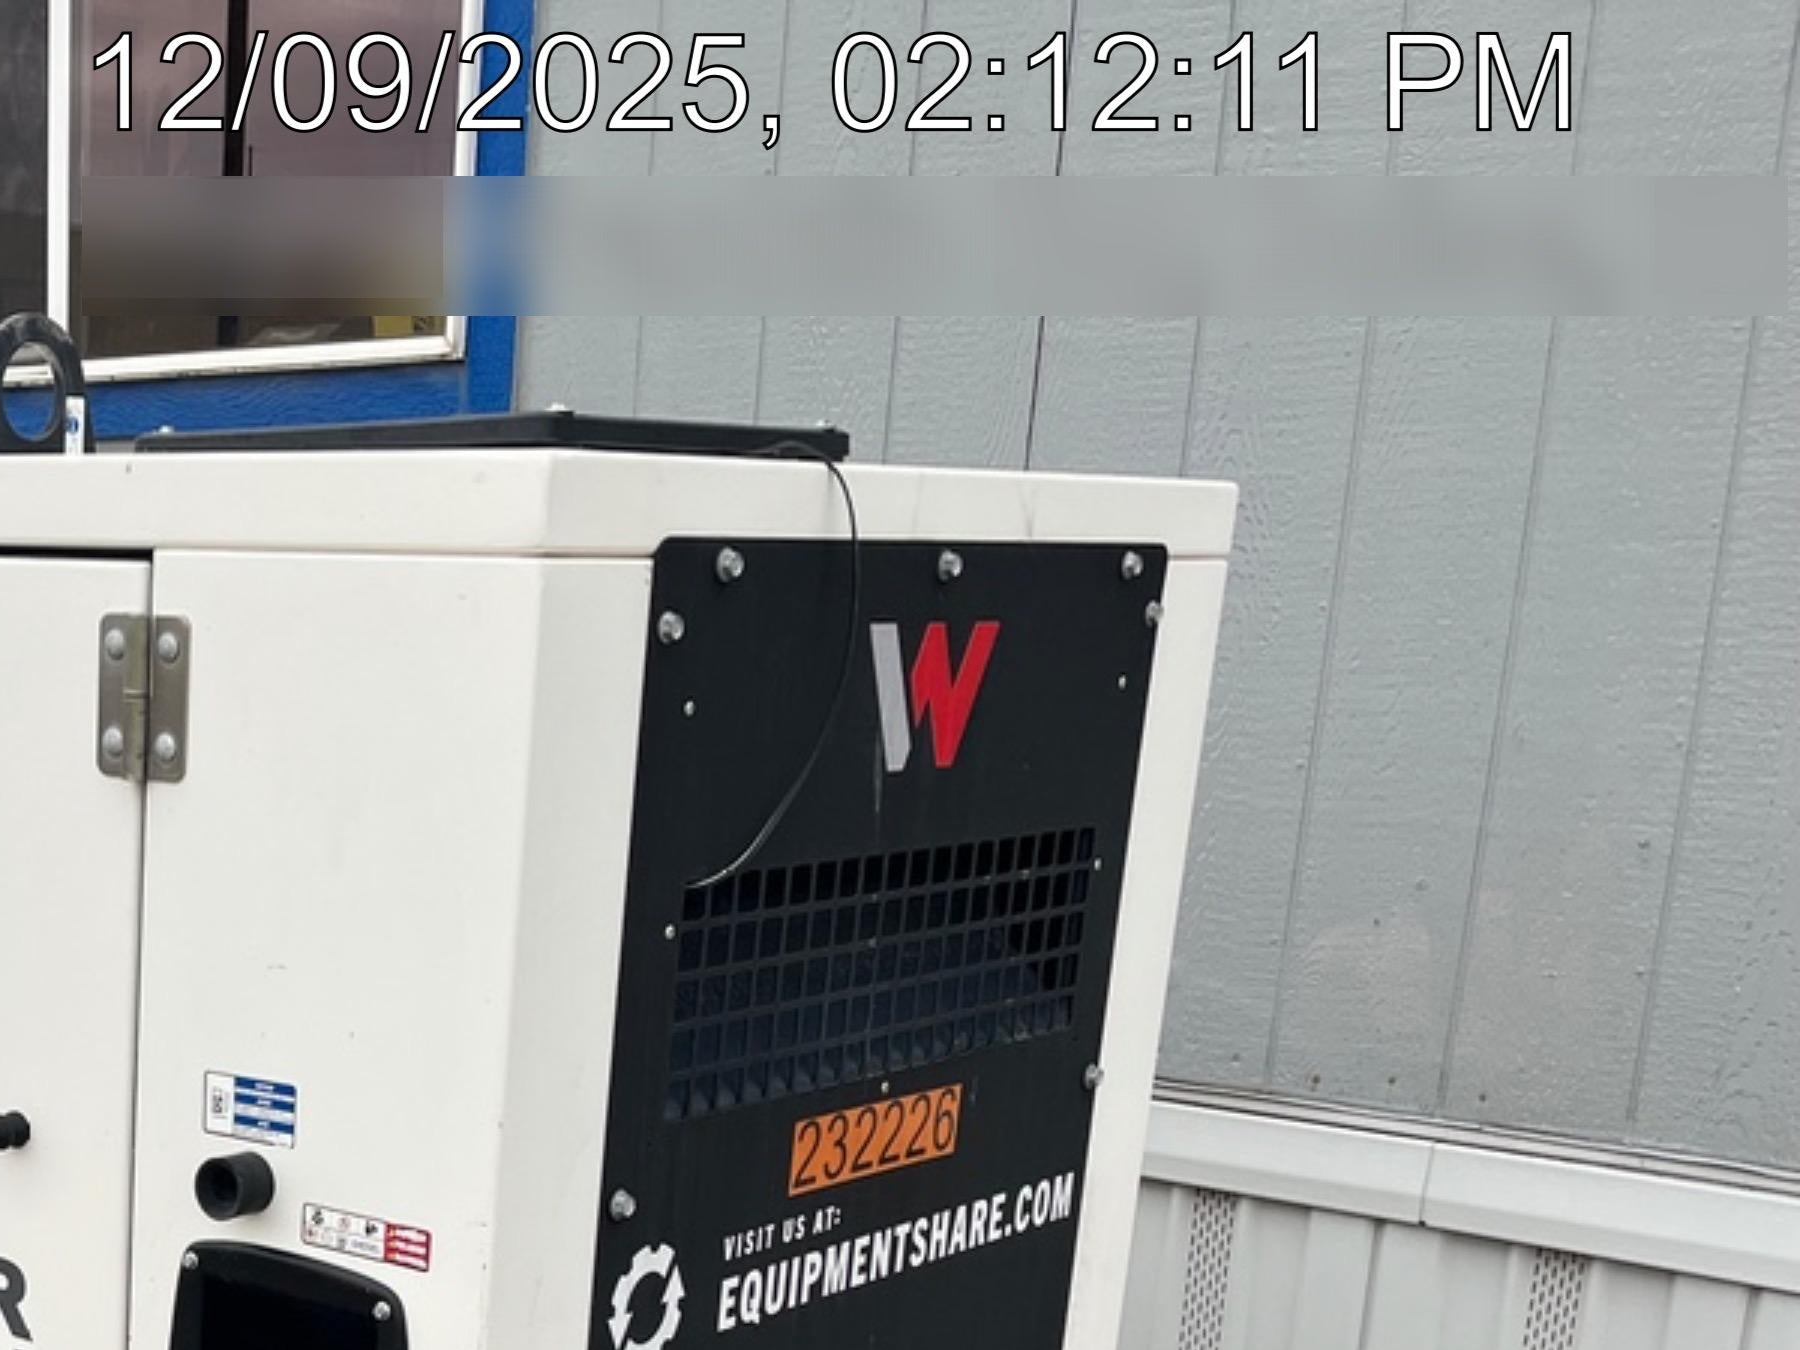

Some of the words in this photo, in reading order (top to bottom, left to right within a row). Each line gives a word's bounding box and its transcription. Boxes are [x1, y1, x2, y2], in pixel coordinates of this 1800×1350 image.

[792, 1089, 957, 1189] 232226
[717, 1172, 1075, 1332] EQUIPMENTSHARE.COM
[724, 1225, 775, 1261] VISIT
[782, 1214, 806, 1242] US
[813, 1206, 841, 1236] AT:
